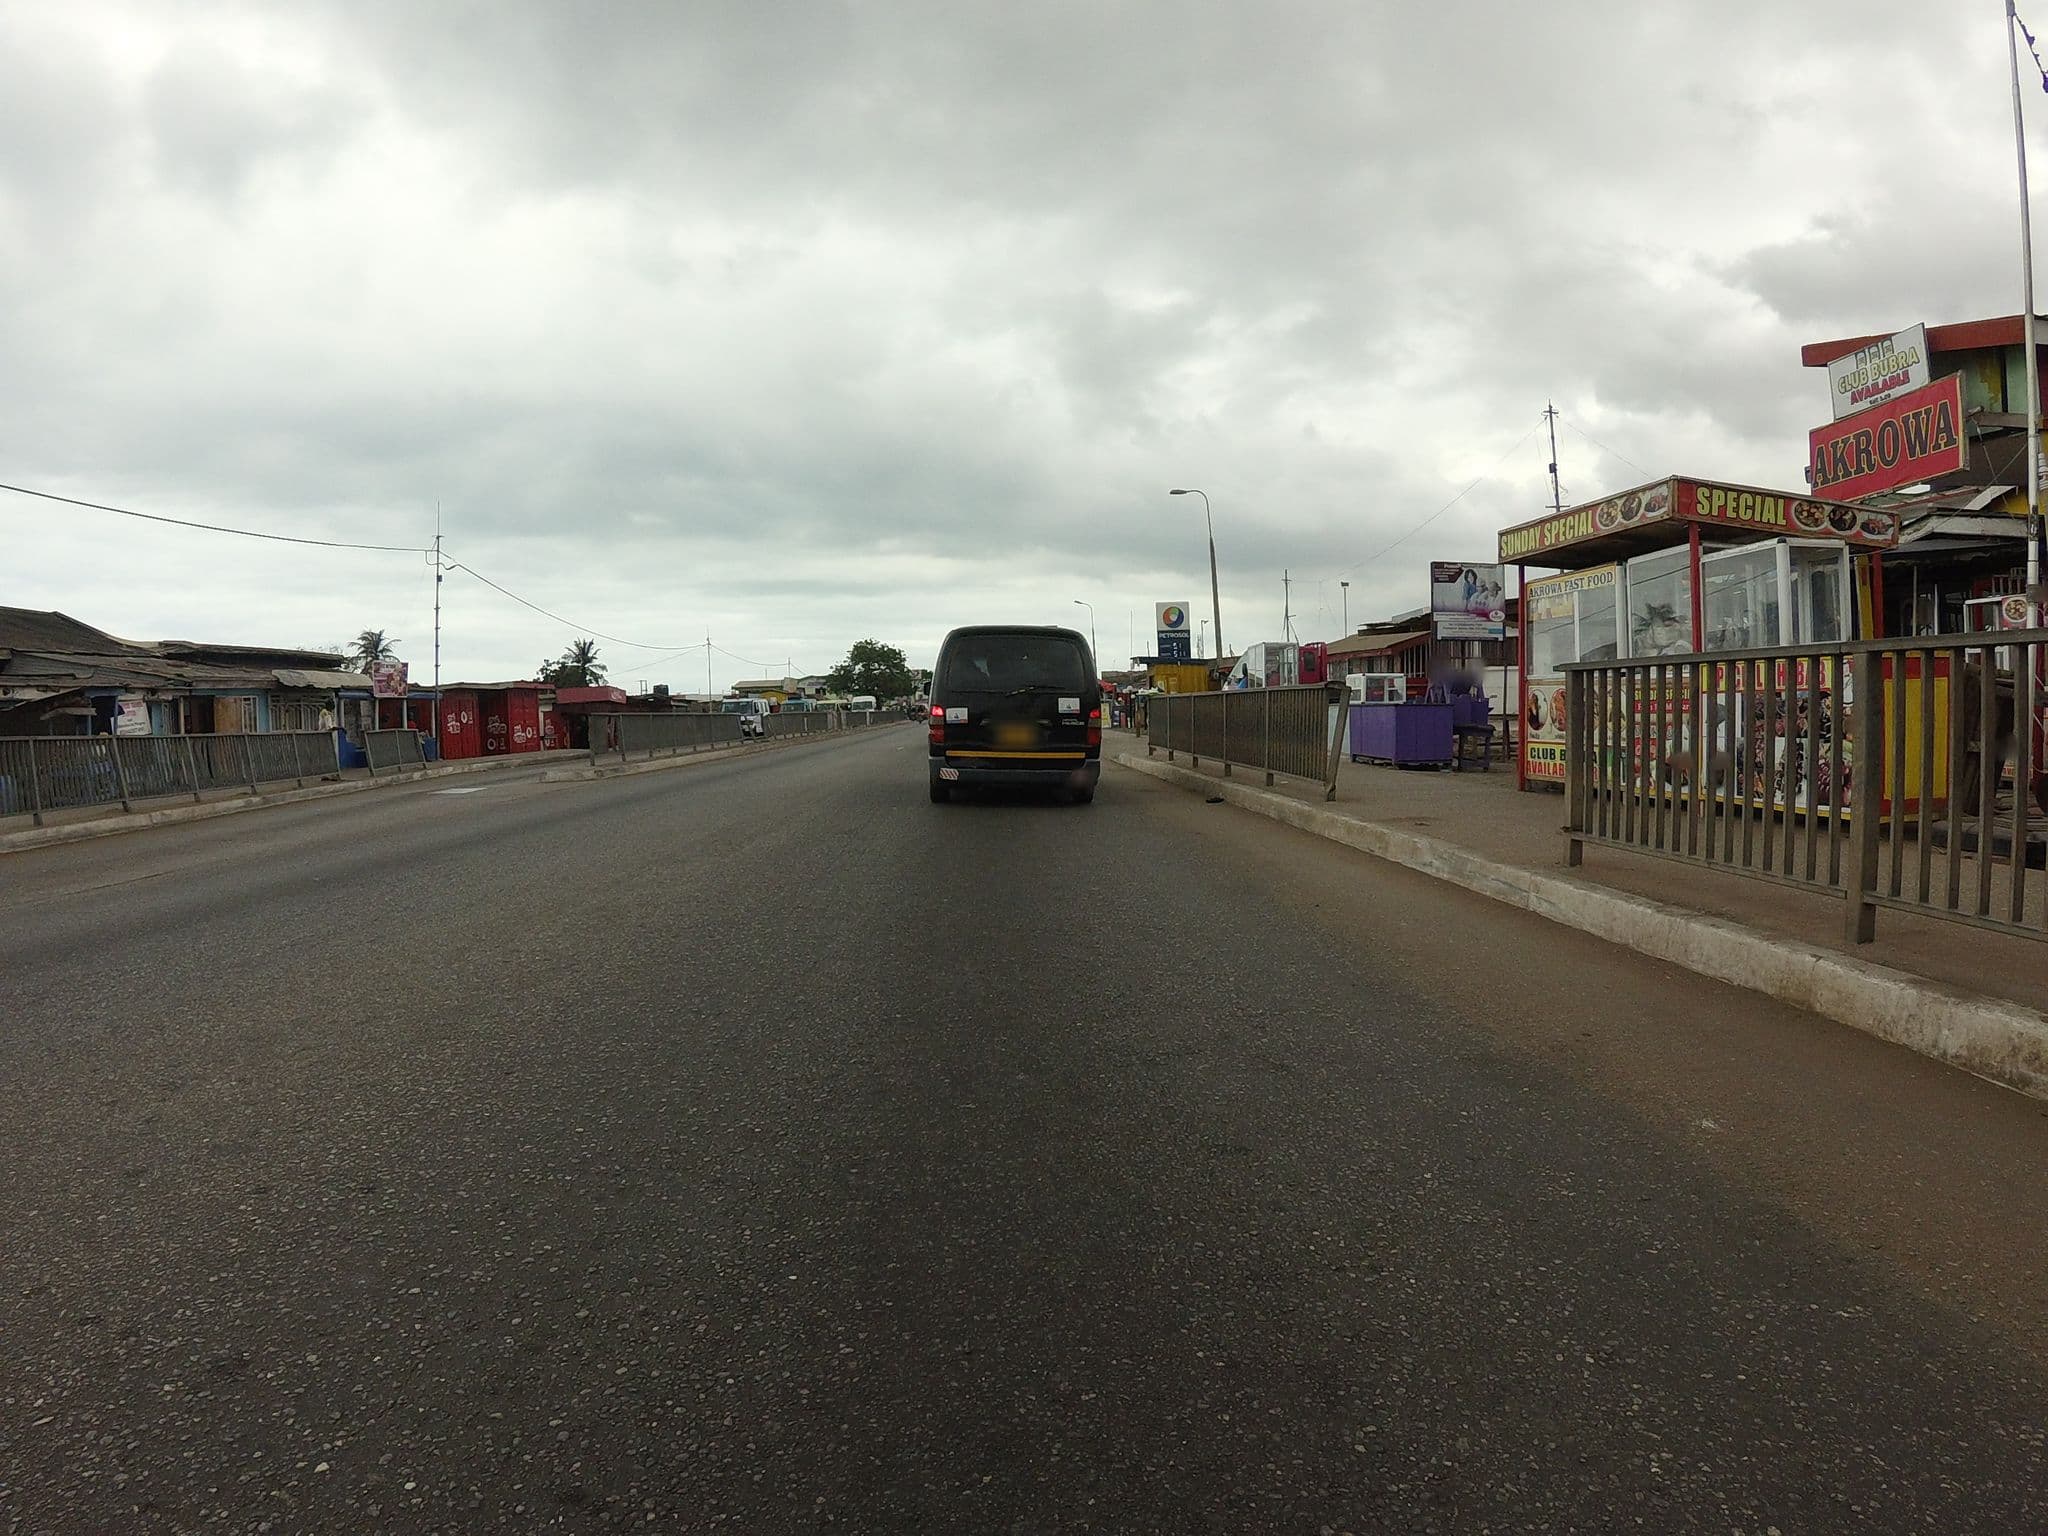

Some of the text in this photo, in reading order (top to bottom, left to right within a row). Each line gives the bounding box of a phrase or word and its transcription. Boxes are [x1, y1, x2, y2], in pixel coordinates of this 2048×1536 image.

[1838, 347, 1920, 394] CLUB BUBRA
[1851, 370, 1910, 405] AVAILABLE
[1812, 400, 1958, 489] AKROWA
[1695, 487, 1787, 526] SPECIAL
[1501, 511, 1594, 557] SUNDAY SPECIAL
[1528, 572, 1614, 599] AKROWA FAST FOOD
[1530, 747, 1556, 761] CLUB
